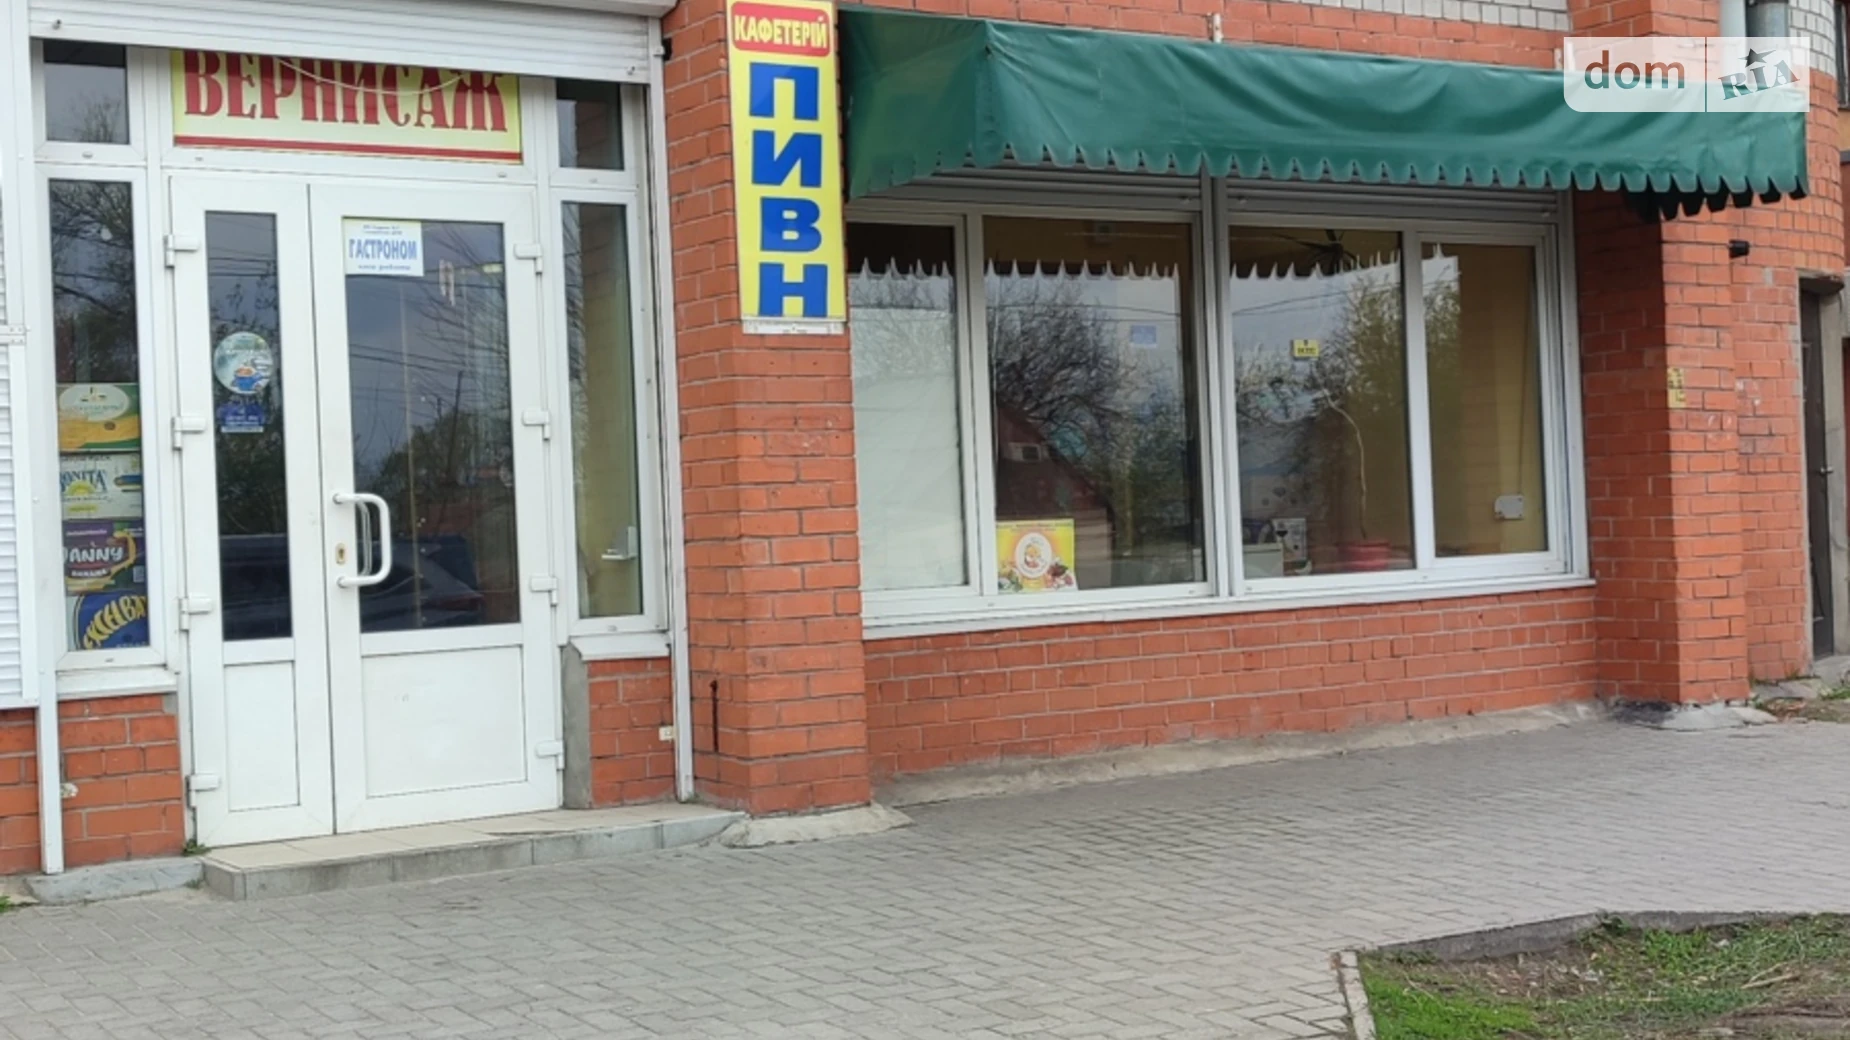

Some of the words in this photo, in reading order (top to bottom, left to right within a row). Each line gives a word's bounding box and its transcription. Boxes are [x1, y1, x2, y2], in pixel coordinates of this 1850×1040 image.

[734, 15, 828, 49] КАФЕТЕРІЙ
[183, 51, 507, 132] ВЕРНИСАЖ
[749, 62, 828, 317] ПИВН
[348, 239, 417, 260] ГАСТРОНОМ
[62, 546, 123, 563] ANNY
